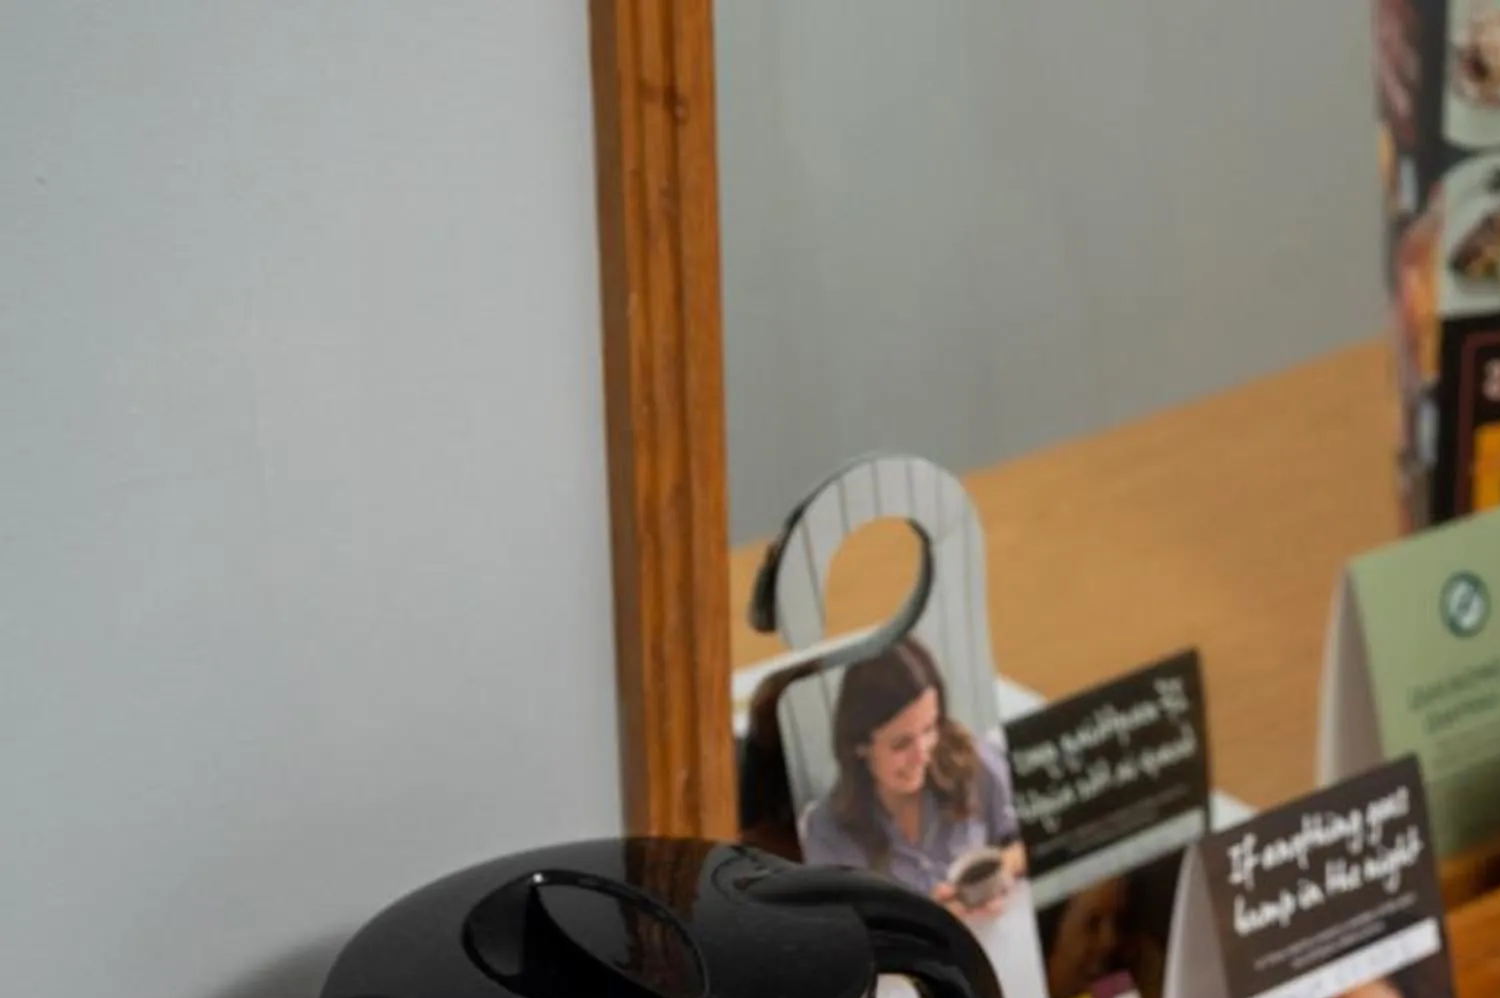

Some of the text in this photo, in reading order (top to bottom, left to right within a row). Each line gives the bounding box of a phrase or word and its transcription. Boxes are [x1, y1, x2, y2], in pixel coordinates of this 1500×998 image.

[1227, 832, 1256, 890] If
[1261, 809, 1364, 870] anything
[1365, 784, 1410, 847] goes
[1233, 889, 1297, 937] bump
[1296, 877, 1325, 911] in
[1325, 857, 1363, 896] the
[1362, 824, 1424, 895] night
